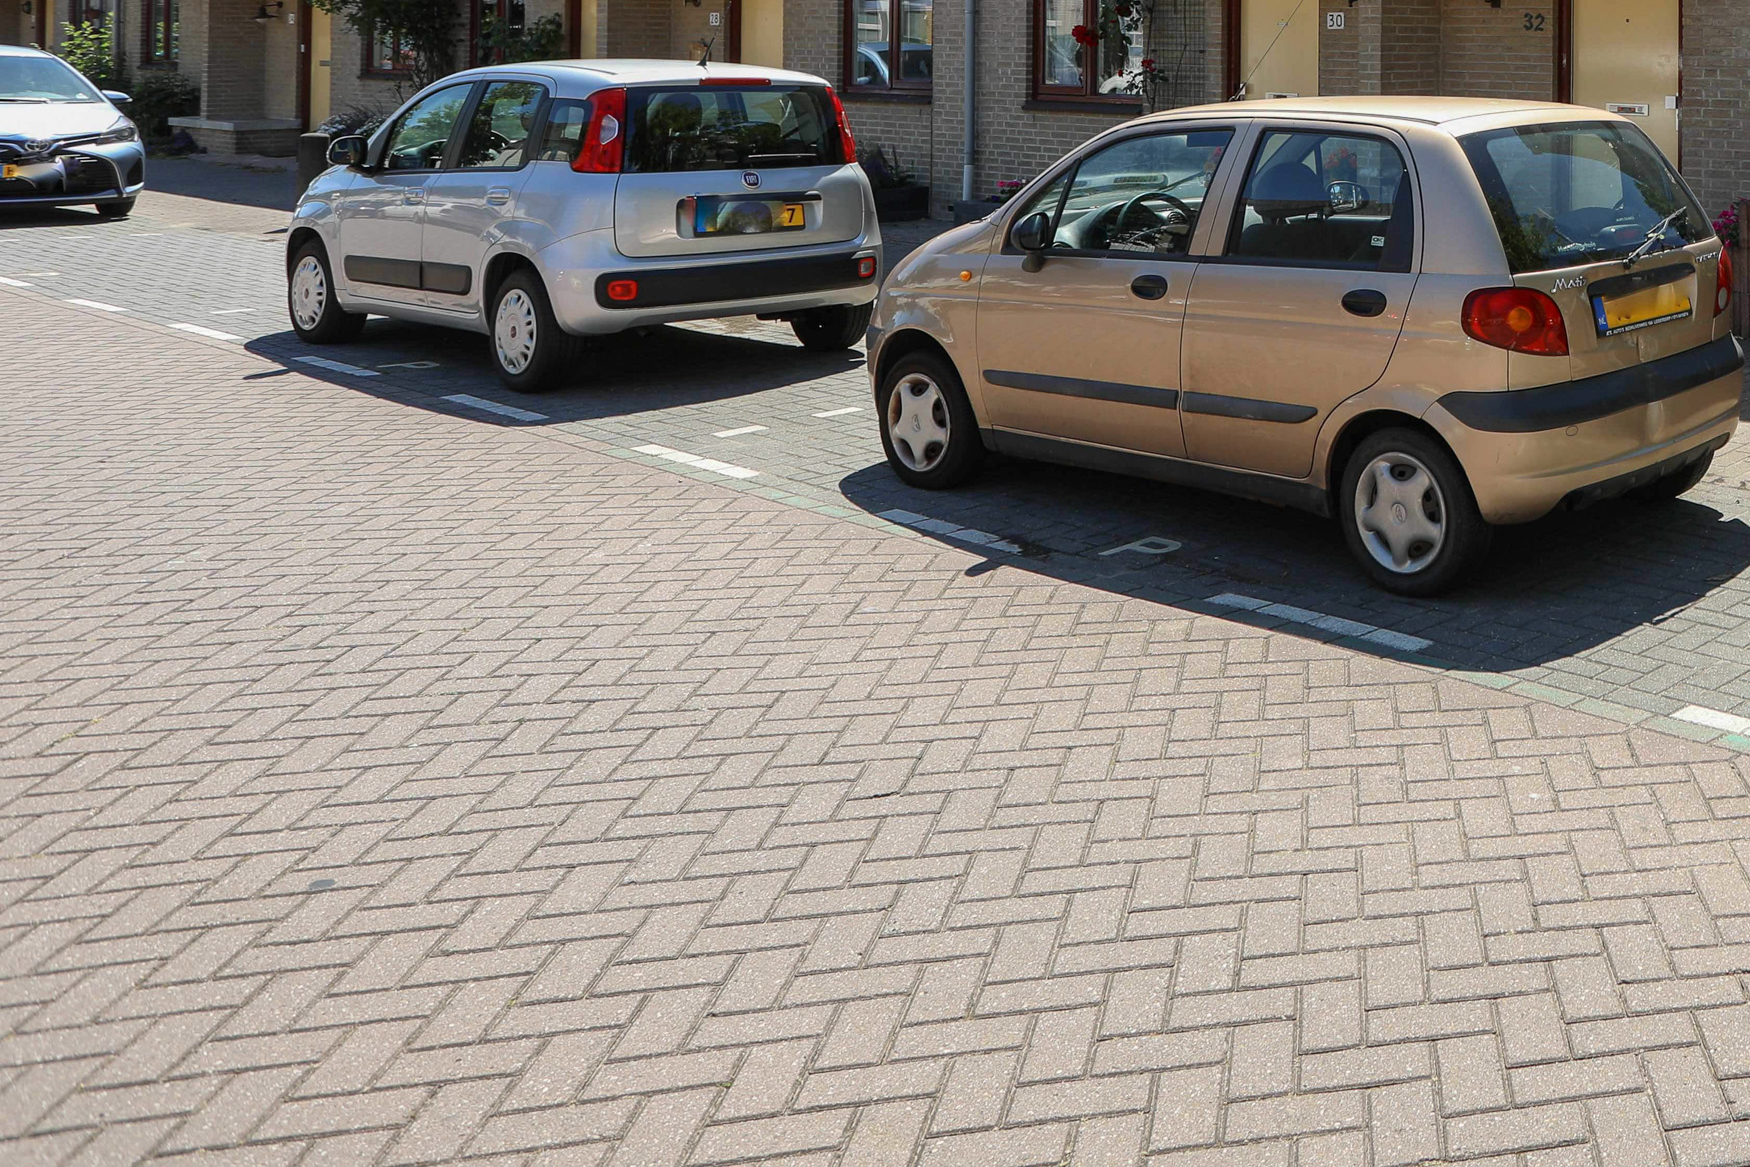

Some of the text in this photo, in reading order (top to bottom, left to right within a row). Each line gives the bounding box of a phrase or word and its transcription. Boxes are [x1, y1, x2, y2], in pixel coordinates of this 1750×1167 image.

[1328, 14, 1343, 28] 30
[1523, 12, 1545, 32] 32
[1098, 536, 1182, 556] P
